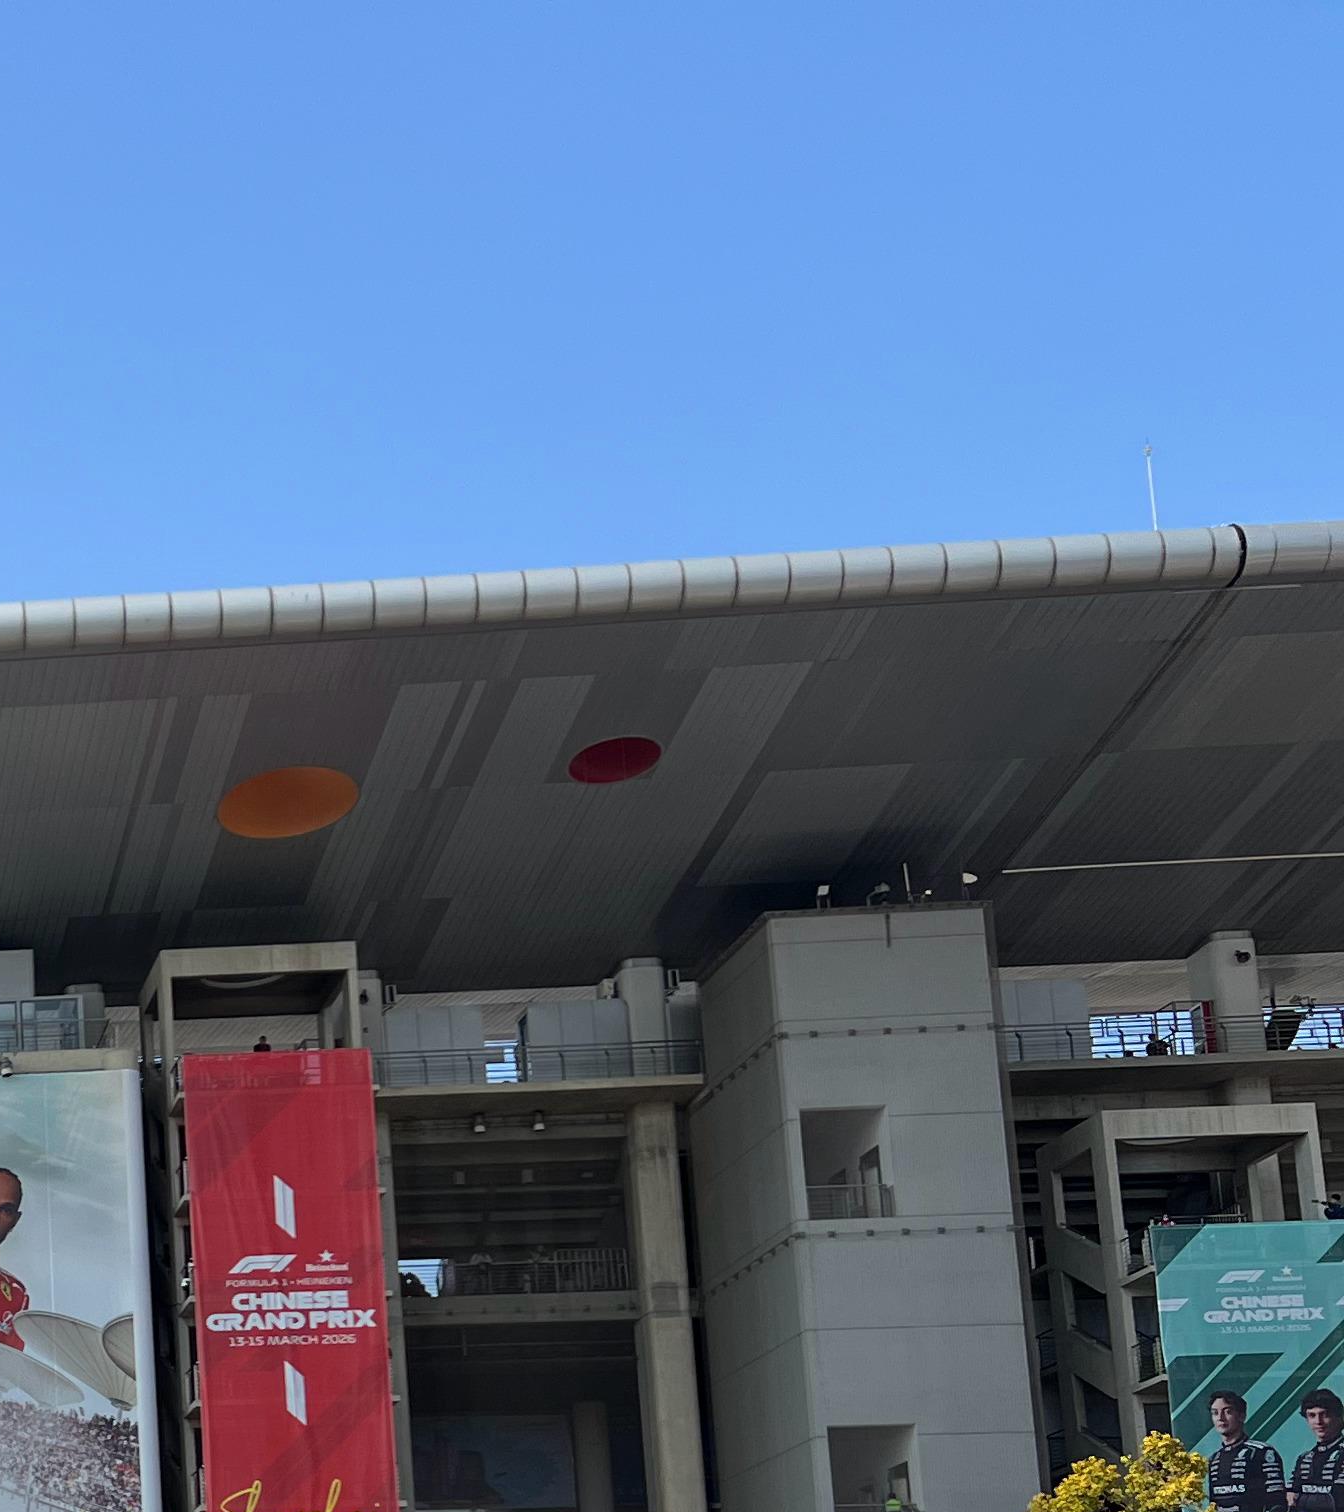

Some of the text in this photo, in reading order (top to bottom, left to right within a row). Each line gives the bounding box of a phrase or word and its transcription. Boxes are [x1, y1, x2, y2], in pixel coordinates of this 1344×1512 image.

[231, 1290, 350, 1311] CHINESE
[1220, 1294, 1305, 1310] CHINESE
[205, 1308, 377, 1332] GRAND PRIX
[1203, 1306, 1325, 1324] GRAND PRIX
[228, 1333, 358, 1347] 13-15 MARCH 2026
